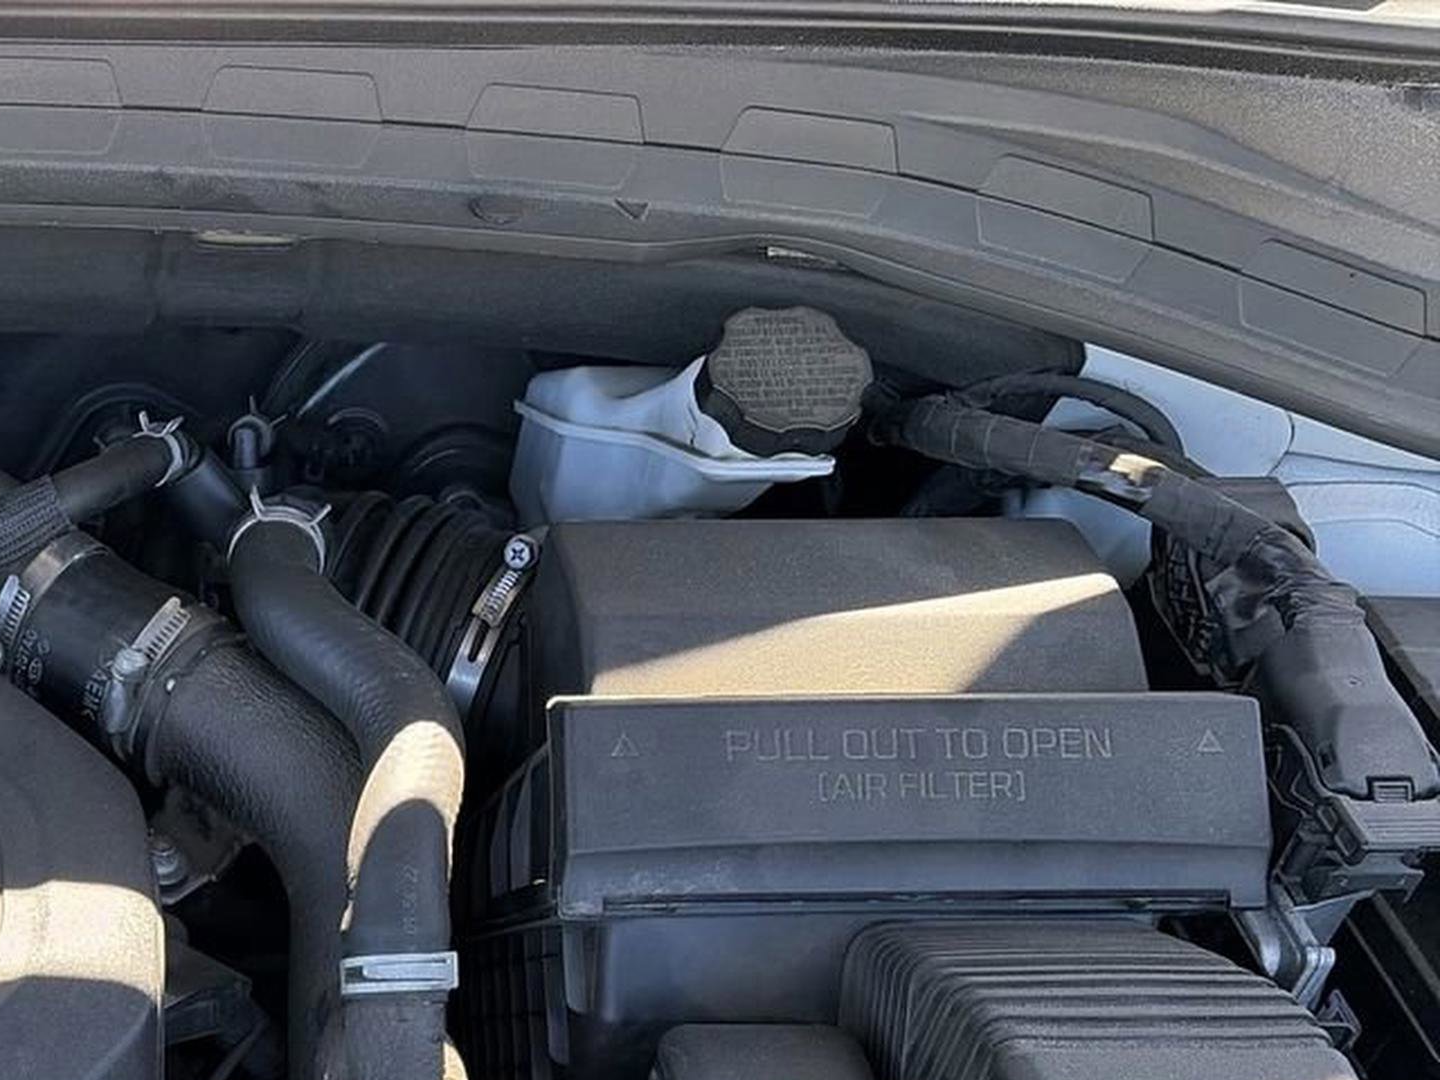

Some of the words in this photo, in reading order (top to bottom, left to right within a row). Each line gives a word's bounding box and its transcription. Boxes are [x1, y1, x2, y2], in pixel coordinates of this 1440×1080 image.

[725, 729, 829, 762] PULL
[842, 728, 921, 761] OUT
[935, 727, 989, 760] TO
[1002, 727, 1112, 759] OPEN
